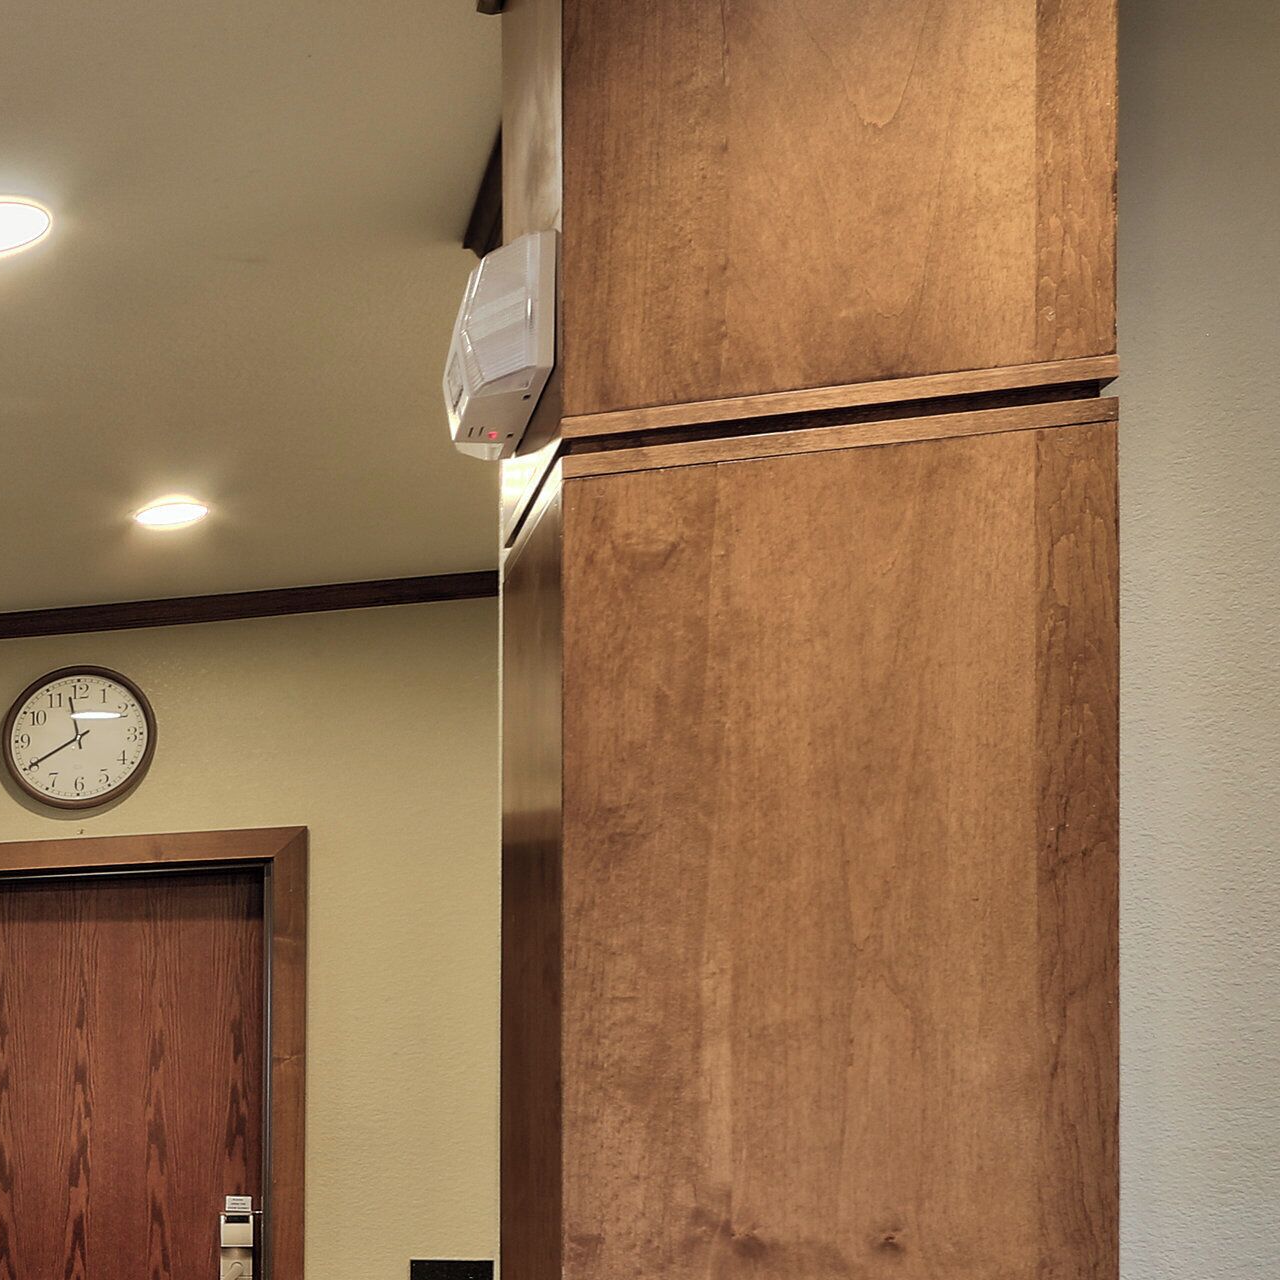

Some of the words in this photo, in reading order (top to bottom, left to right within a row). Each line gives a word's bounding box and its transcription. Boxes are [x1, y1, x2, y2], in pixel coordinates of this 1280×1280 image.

[72, 684, 89, 699] 12
[100, 689, 106, 703] 1
[49, 694, 62, 708] 11
[118, 703, 128, 718] 2
[31, 712, 46, 726] 10
[20, 734, 30, 748] 9
[127, 728, 137, 742] 3
[29, 757, 39, 770] 8
[117, 750, 127, 764] 4
[49, 773, 58, 787] 7
[99, 769, 109, 783] 5
[74, 777, 84, 791] 6
